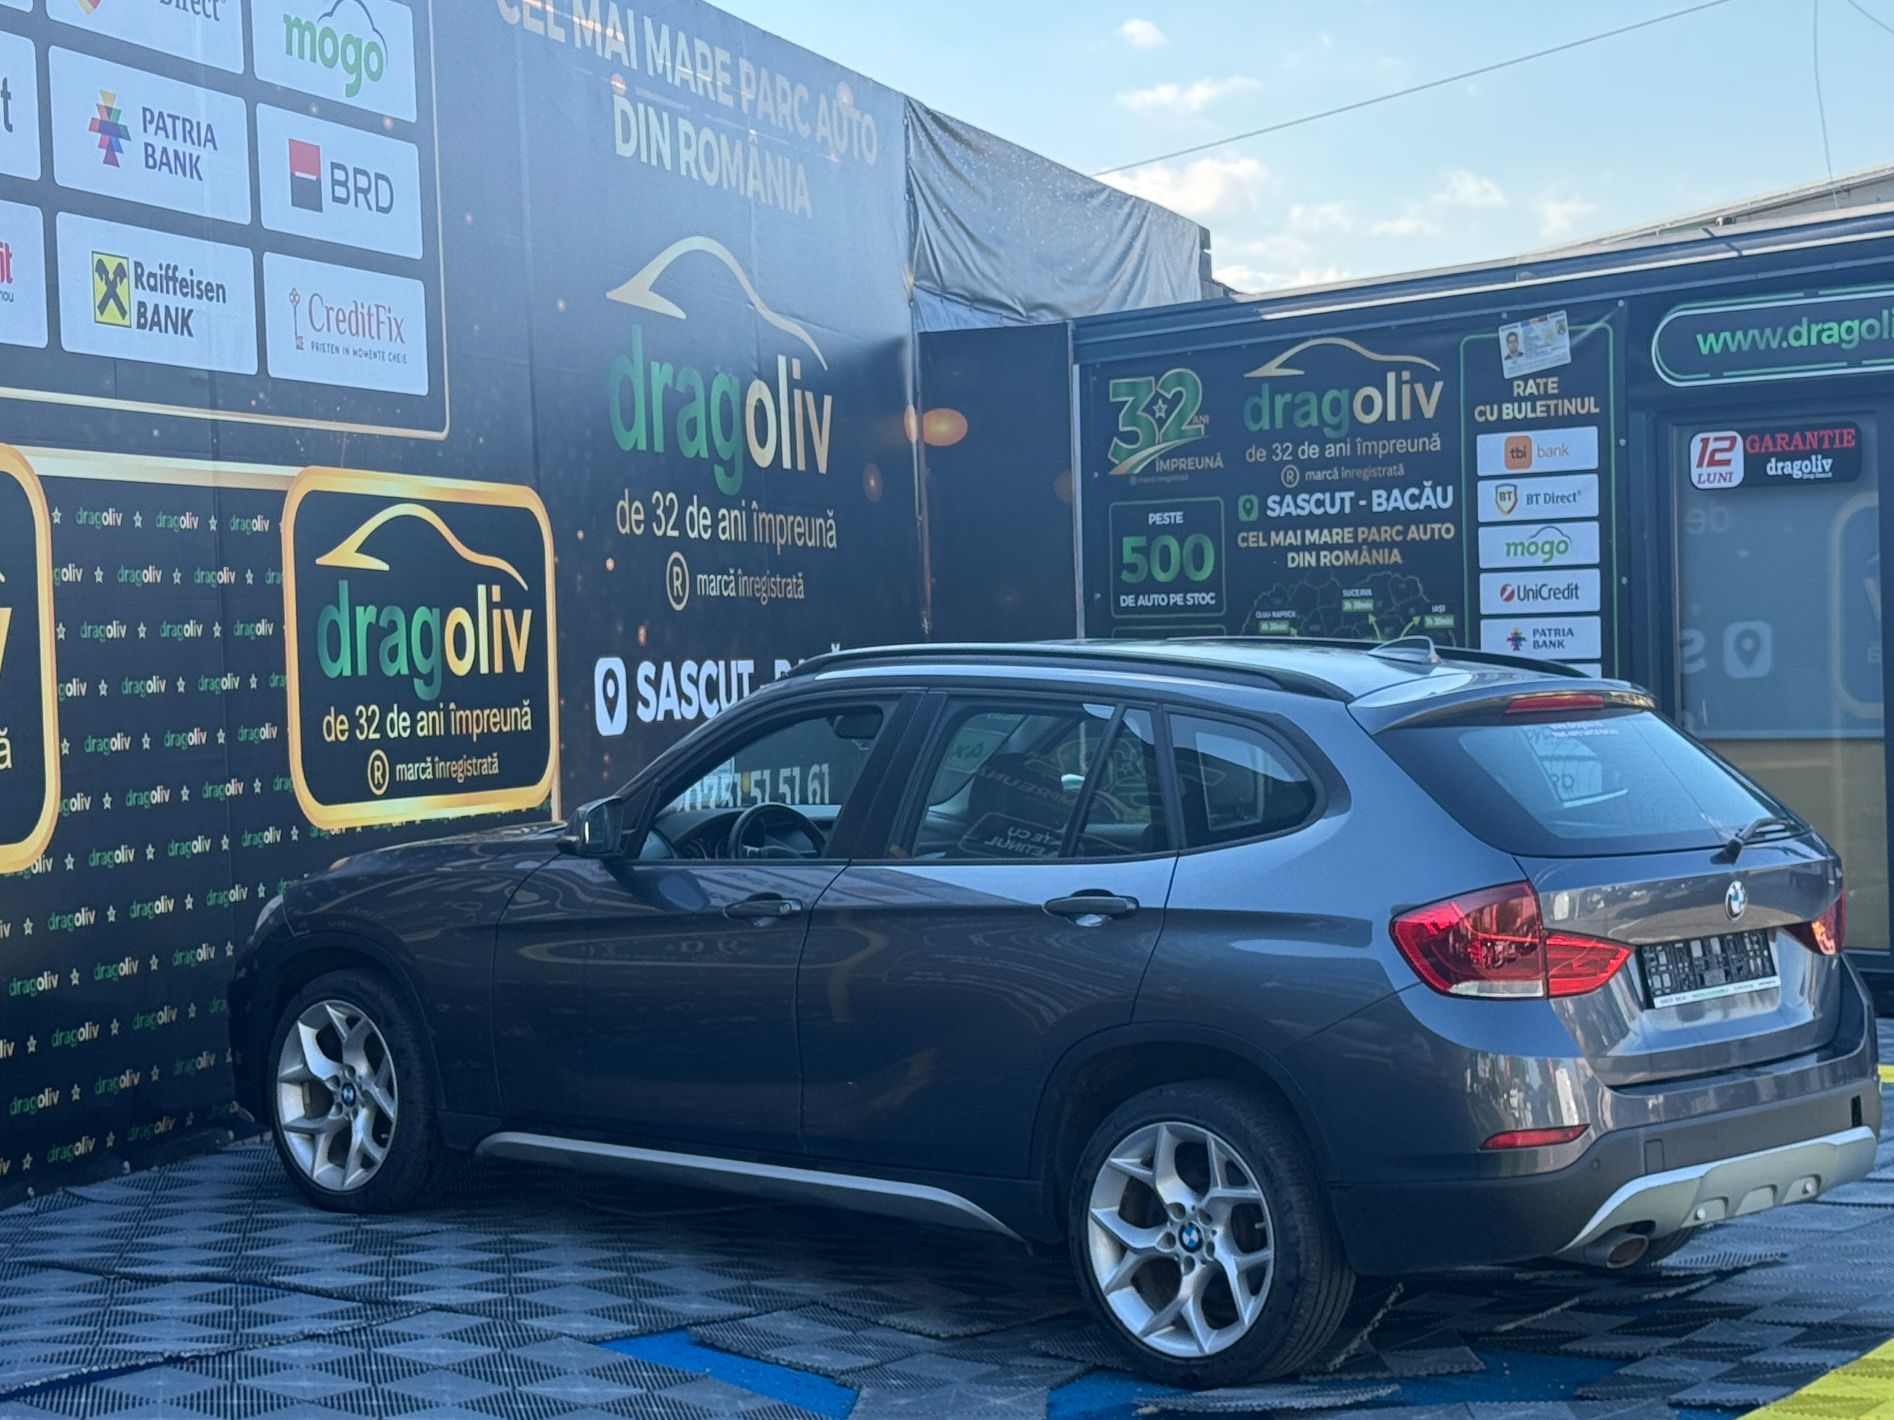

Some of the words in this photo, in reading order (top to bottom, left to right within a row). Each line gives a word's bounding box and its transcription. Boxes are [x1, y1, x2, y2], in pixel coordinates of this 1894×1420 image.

[283, 13, 385, 98] mogo
[572, 0, 638, 70] MAI
[643, 16, 734, 107] MARE
[739, 58, 810, 139] PARC
[816, 94, 878, 165] AUTO
[142, 106, 219, 152] PATRIA
[144, 142, 204, 182] BANK
[613, 95, 672, 171] DIN
[678, 118, 813, 219] ROMÂNIA
[329, 161, 394, 215] BRD
[133, 260, 227, 304] Raiffeisen
[135, 304, 195, 339] BANK
[308, 292, 406, 345] CreditFix
[310, 340, 340, 355] PRIETEN
[1512, 377, 1559, 397] RATE
[608, 323, 833, 496] dragoliv
[1108, 368, 1203, 465] 32
[1242, 371, 1444, 440] dragoliv
[1474, 405, 1498, 423] CU
[1501, 397, 1600, 421] BULETINUL
[1245, 445, 1267, 463] de
[1271, 443, 1293, 461] 32
[1297, 440, 1320, 459] de
[1324, 438, 1351, 458] ani
[1355, 433, 1442, 460] împreună
[1509, 445, 1527, 459] tbi
[1536, 443, 1570, 458] bank
[1696, 435, 1738, 469] 12
[1745, 428, 1857, 454] GARANTIE
[1305, 467, 1340, 482] marcă
[1696, 472, 1734, 485] LUNI
[1766, 454, 1834, 479] dragoliv
[1266, 491, 1356, 518] SASCUT
[1371, 481, 1455, 513] BACĂU
[1526, 493, 1542, 506] BT
[76, 507, 123, 530] dragoliv
[156, 511, 199, 533] dragoliv
[230, 514, 270, 536] dragoliv
[616, 488, 646, 537] de
[651, 491, 680, 538] 32
[685, 495, 713, 541] de
[717, 499, 747, 543] ani
[752, 501, 838, 555] împreună
[1148, 511, 1184, 526] PESTE
[1237, 531, 1267, 548] CEL
[1270, 530, 1302, 547] MAI
[1304, 527, 1353, 546] MARE
[1357, 525, 1403, 544] PARC
[1406, 523, 1455, 542] AUTO
[1120, 533, 1215, 584] 500
[1287, 552, 1316, 569] DIN
[1318, 547, 1403, 568] ROMÂNIA
[1504, 539, 1570, 564] mogo
[117, 565, 163, 588] dragoliv
[194, 567, 236, 588] dragoliv
[696, 566, 736, 598] marcă
[738, 567, 805, 606] înregistrată
[1516, 582, 1580, 602] UniCredit
[1120, 594, 1136, 607] DE
[1137, 593, 1168, 607] AUTO
[1169, 593, 1184, 606] PE
[1185, 592, 1216, 606] STOC
[80, 620, 127, 643] dragoliv
[160, 620, 204, 642] dragoliv
[233, 619, 275, 641] dragoliv
[315, 580, 533, 701] dragoliv
[1532, 627, 1575, 639] PATRIA
[1532, 639, 1566, 650] BANK
[121, 675, 167, 698] dragoliv
[198, 672, 241, 695] dragoliv
[636, 659, 755, 723] SASCUT
[322, 706, 349, 743] de
[355, 704, 381, 740] 32
[386, 702, 411, 738] de
[416, 699, 445, 737] ani
[449, 699, 533, 744] împreună
[84, 732, 132, 756] dragoliv
[164, 727, 208, 751] dragoliv
[237, 723, 278, 745] dragoliv
[395, 755, 433, 782] marcă
[434, 753, 499, 785] înregistrată
[125, 785, 171, 809] dragoliv
[202, 778, 245, 801] dragoliv
[89, 844, 136, 869] dragoliv
[168, 835, 212, 858] dragoliv
[242, 826, 282, 849] dragoliv
[48, 907, 96, 933] dragoliv
[130, 895, 175, 919] dragoliv
[206, 884, 249, 907] dragoliv
[8, 971, 59, 997] dragoliv
[93, 957, 139, 982] dragoliv
[172, 943, 216, 968] dragoliv
[51, 1021, 100, 1048] dragoliv
[132, 1005, 178, 1031] dragoliv
[9, 1087, 61, 1116] dragoliv
[94, 1069, 141, 1096] dragoliv
[47, 1136, 96, 1164] dragoliv
